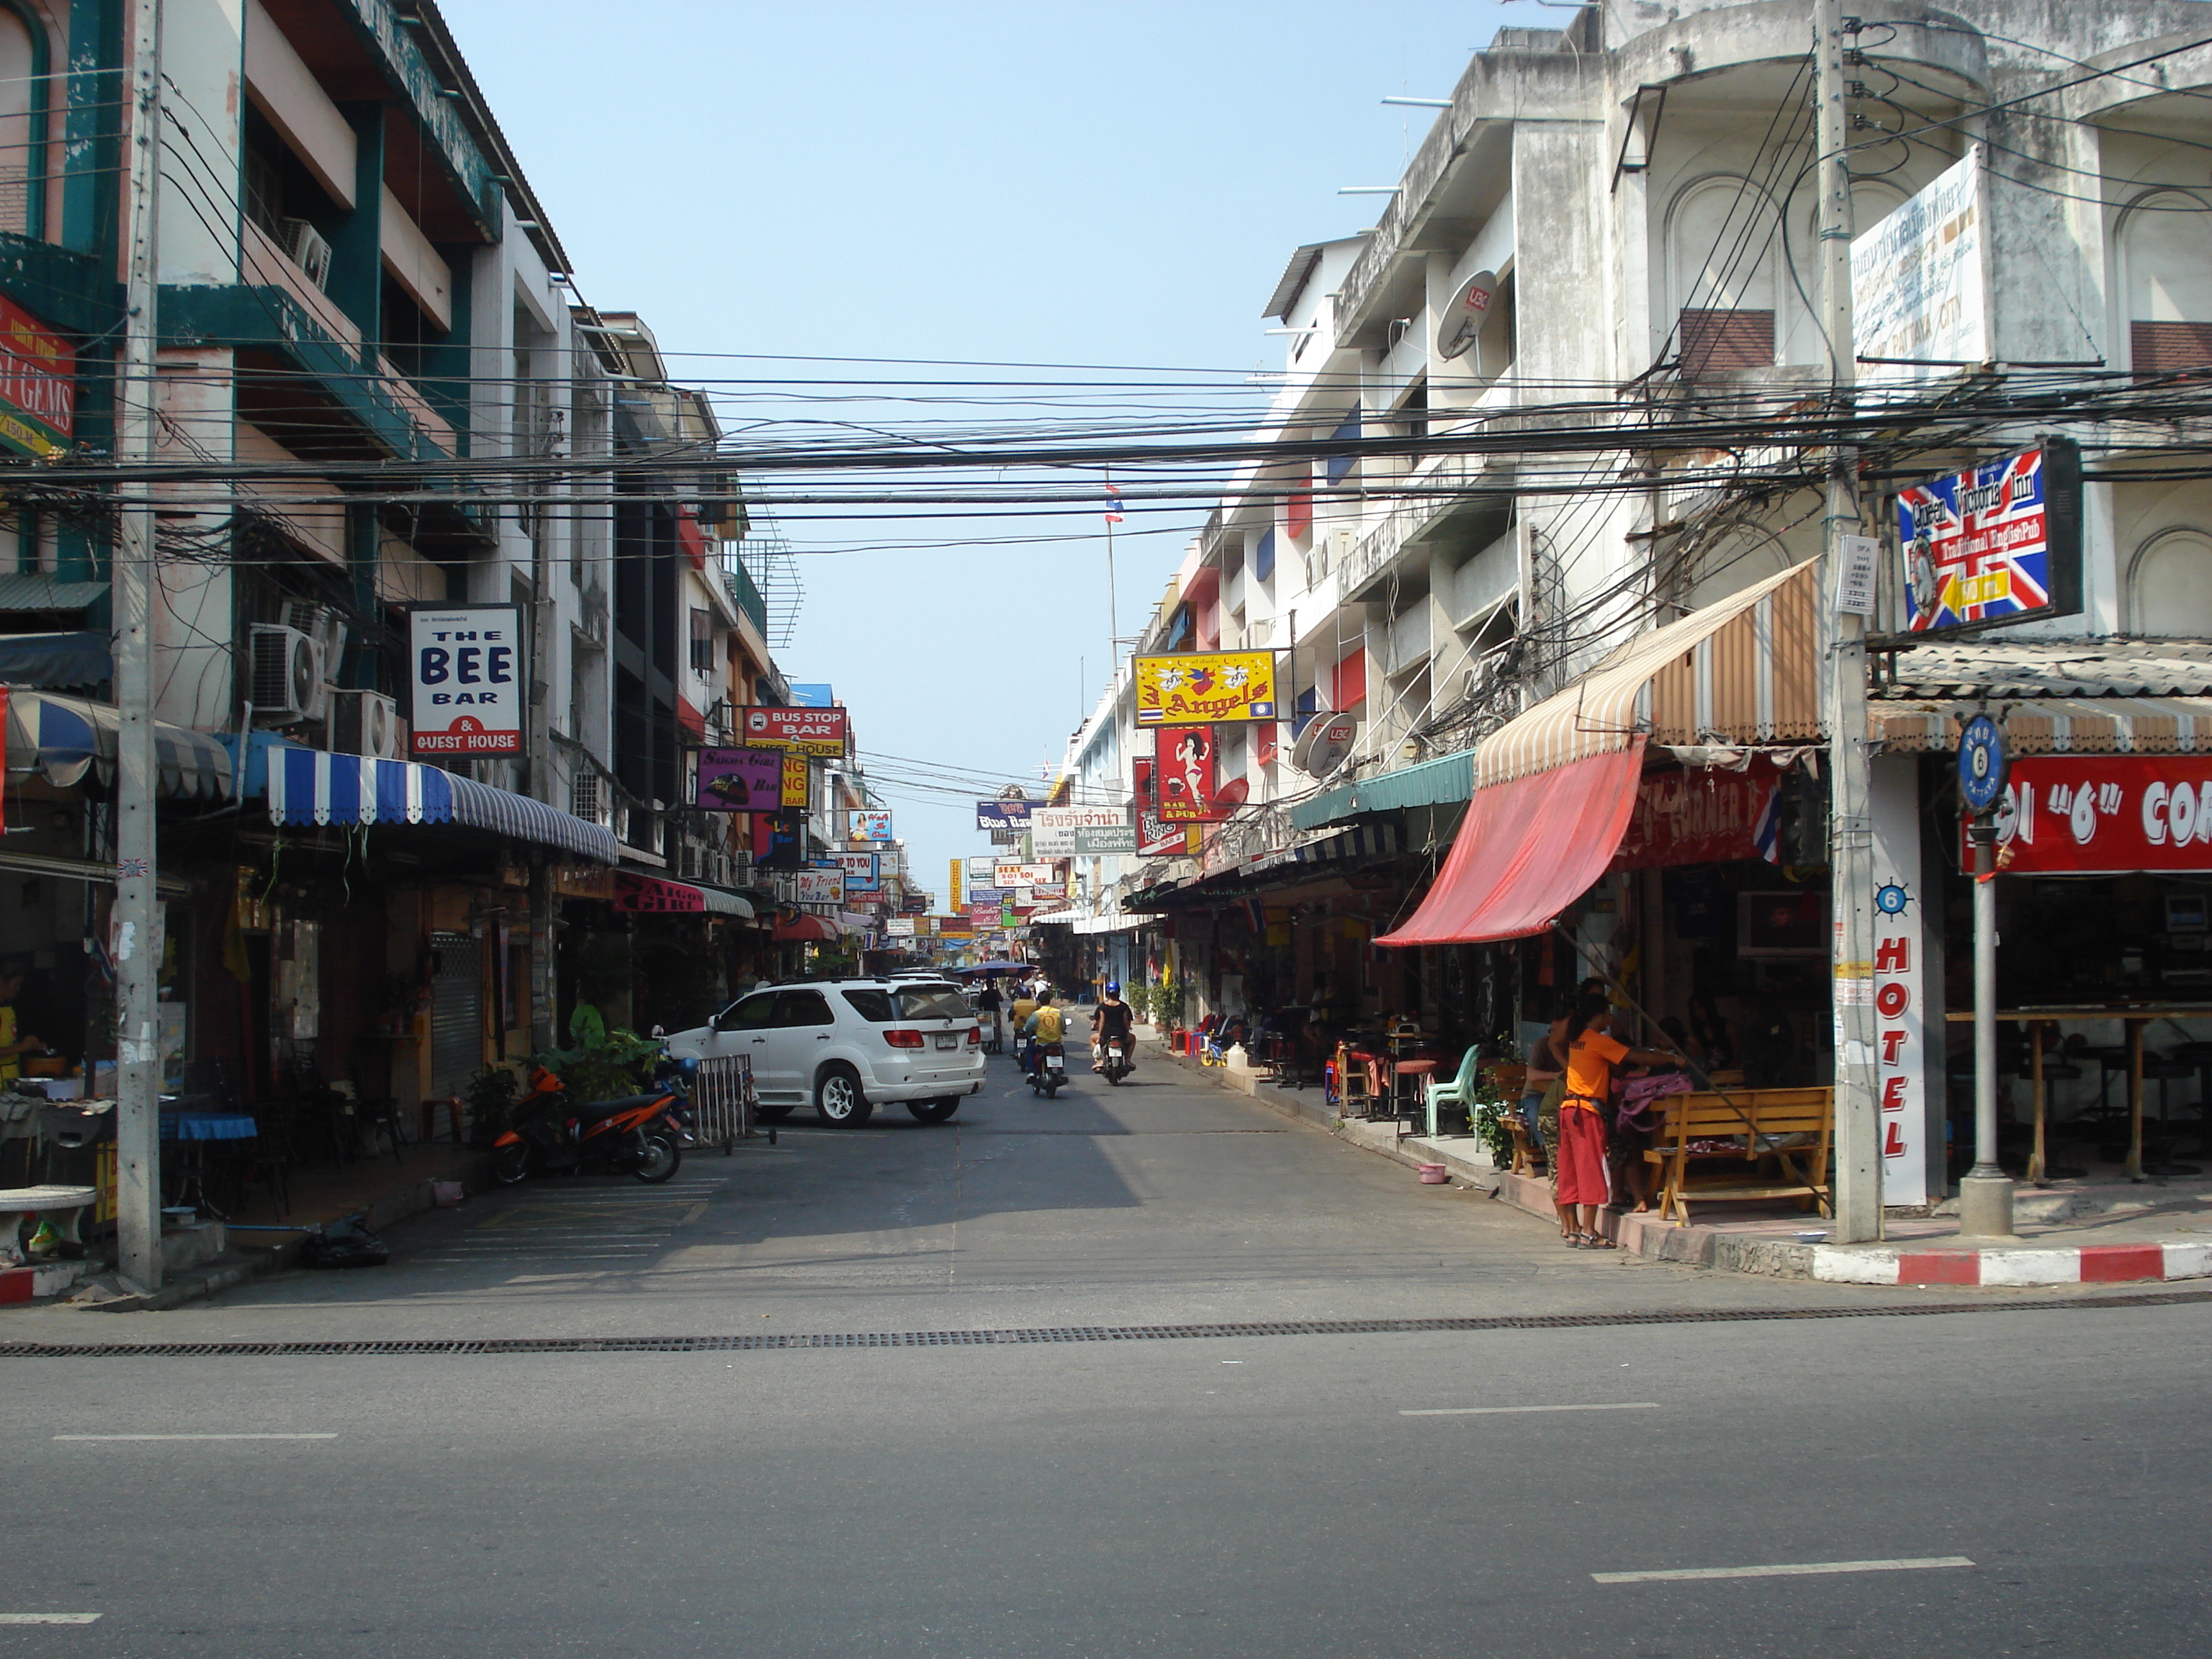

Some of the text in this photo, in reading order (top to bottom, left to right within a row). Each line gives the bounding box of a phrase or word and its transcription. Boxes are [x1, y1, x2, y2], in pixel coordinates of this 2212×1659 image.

[21, 360, 71, 431] GEMS
[5, 419, 22, 439] 150
[1912, 470, 2035, 534] Queen Victoria Inn
[1941, 532, 1988, 561] Traditional
[431, 631, 503, 642] THE
[421, 647, 512, 685] BEE
[432, 693, 498, 705] BAR
[1143, 681, 1268, 719] 3 Angels
[773, 712, 842, 723] BUS STOP
[461, 720, 473, 732] &
[782, 725, 831, 734] BAR
[417, 734, 516, 749] GUEST HOUSE
[796, 745, 839, 755] HOUSE
[1968, 777, 1996, 796] PATTAYA
[979, 815, 1008, 828] Blue
[1038, 809, 1120, 827] โรงรับจำนำ
[1165, 810, 1197, 819] & PUB
[777, 834, 793, 843] Bar
[1160, 837, 1175, 848] BAR
[846, 857, 855, 868] TO
[857, 857, 870, 868] YOU
[616, 873, 703, 902] SAIGON
[800, 876, 811, 890] My
[817, 873, 842, 887] Friend
[624, 894, 695, 910] GIRL
[815, 891, 830, 901] Bar
[1884, 892, 1898, 908] 6
[1875, 937, 1910, 1160] HOTEL
